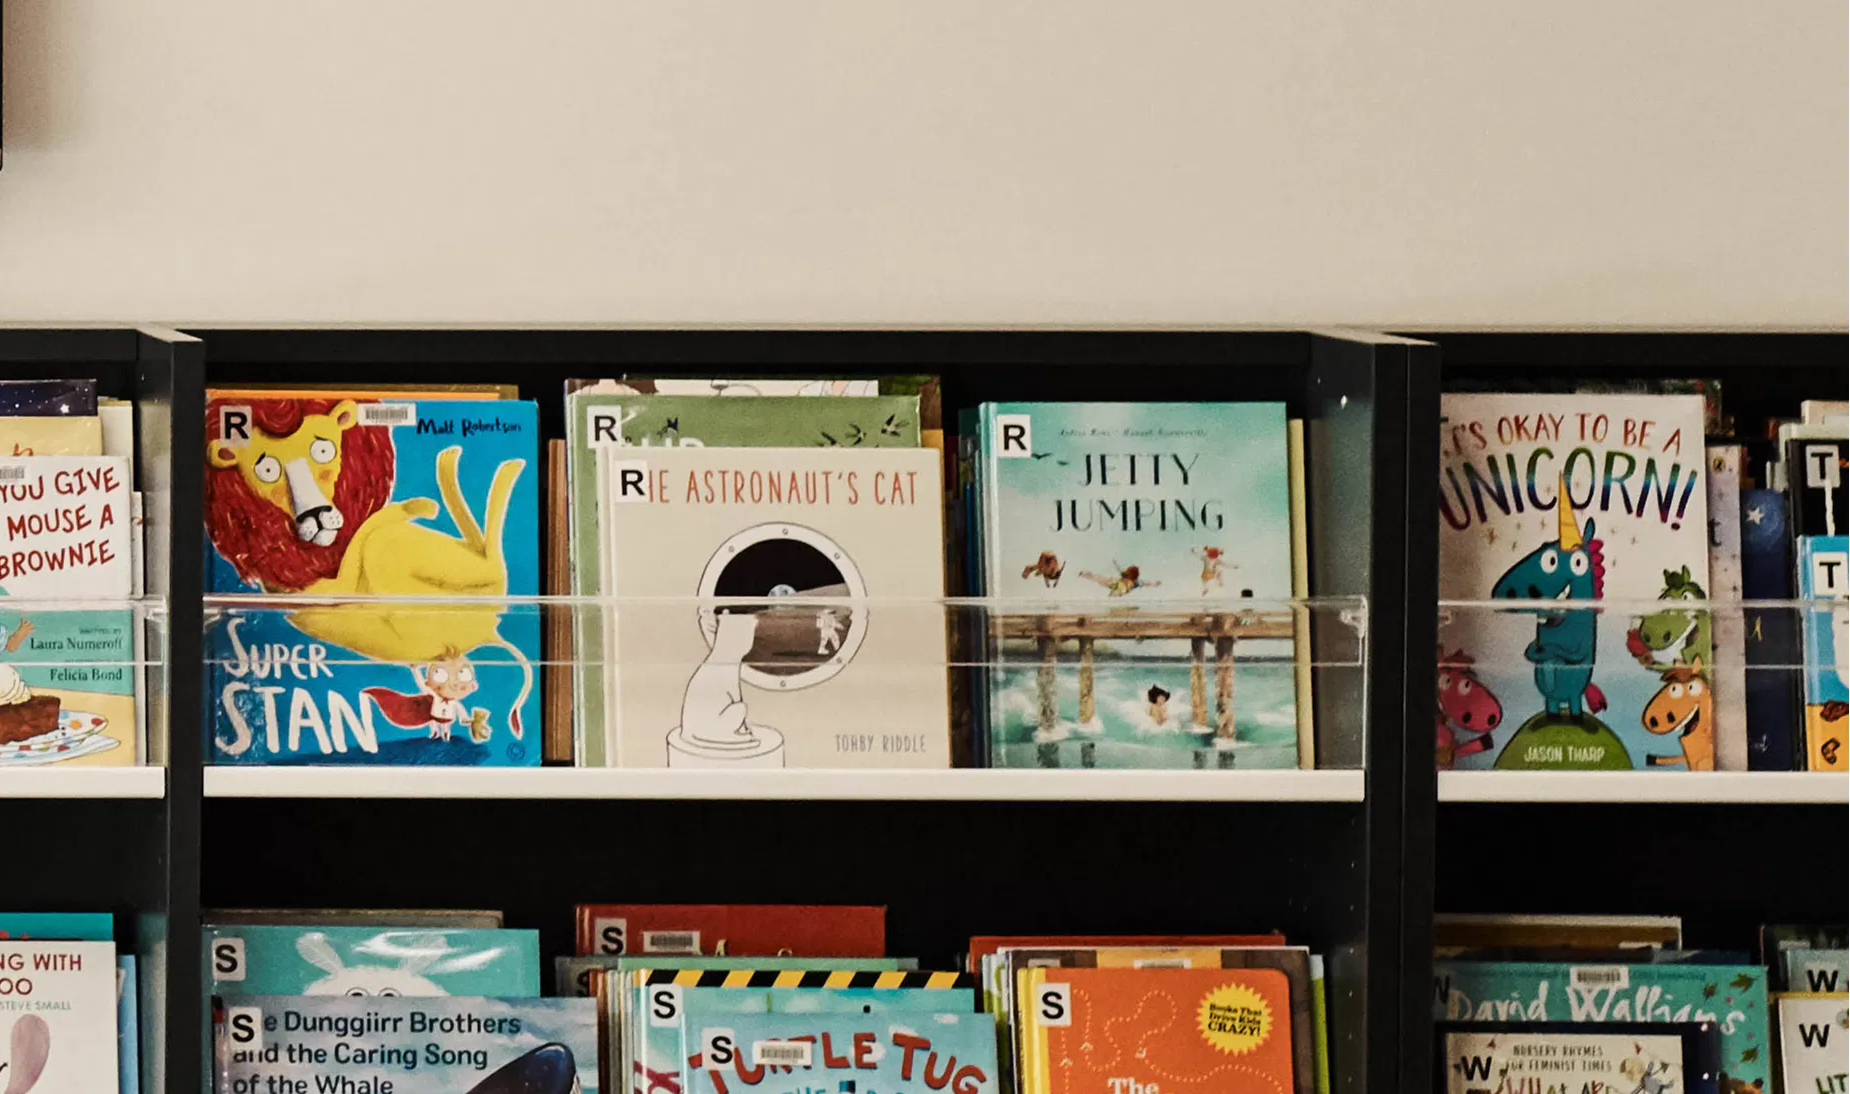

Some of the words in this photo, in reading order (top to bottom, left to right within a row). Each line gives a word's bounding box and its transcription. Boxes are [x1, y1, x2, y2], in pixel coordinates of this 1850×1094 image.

[1497, 413, 1565, 444] OKAY
[1575, 412, 1609, 442] TO
[1623, 418, 1655, 448] BE
[1662, 428, 1681, 455] A
[1077, 453, 1201, 487] JETTY
[1811, 452, 1833, 480] T
[55, 466, 120, 495] GIVE
[621, 468, 645, 497] R
[687, 469, 858, 505] ASTRONAUT'S
[874, 470, 919, 505] CAT
[6, 504, 92, 543] MOUSE
[100, 500, 115, 526] A
[1049, 499, 1223, 533] JUMPING
[30, 637, 63, 651] Laura
[50, 667, 90, 682] Felicia
[94, 667, 123, 682] Bond
[215, 683, 379, 755] STAN
[835, 736, 873, 753] TOHBY
[880, 734, 927, 753] RIDDLE
[1524, 746, 1562, 763] JASON
[1567, 746, 1605, 763] THARP
[601, 926, 624, 956] S
[32, 953, 83, 971] WITH
[1807, 969, 1838, 992] W
[0, 1001, 30, 1011] STEVE
[33, 1001, 72, 1011] SMALL
[409, 1012, 522, 1036] Brothers
[1207, 1021, 1262, 1038] CRAZY!
[286, 1044, 328, 1065] the
[333, 1044, 418, 1070] Caring
[423, 1044, 489, 1071] Song
[710, 1036, 733, 1063] S
[1528, 1060, 1576, 1073] FEMINIST
